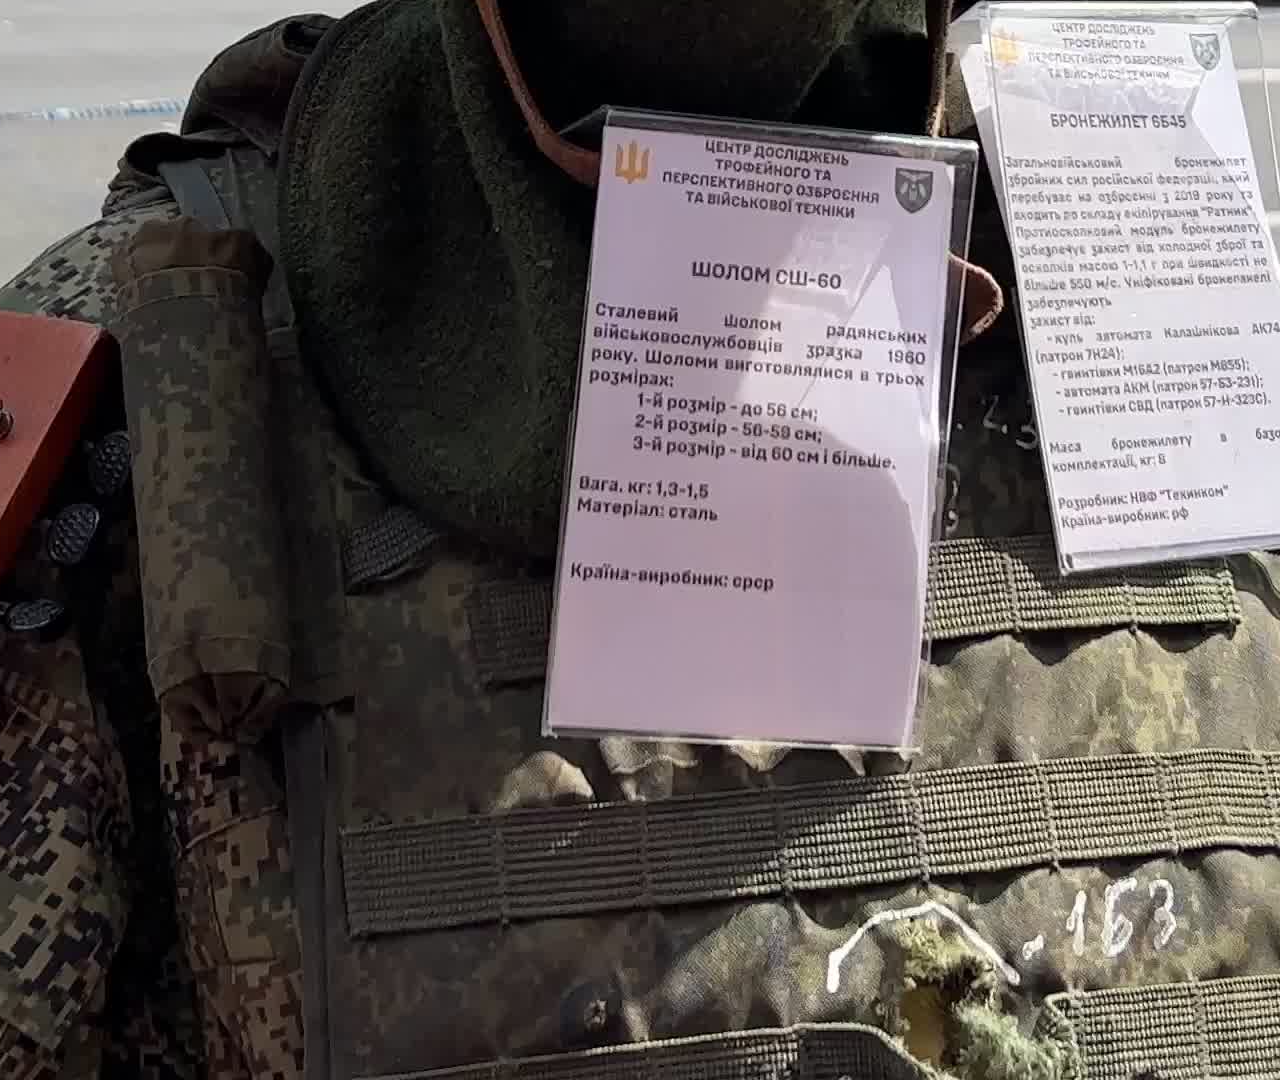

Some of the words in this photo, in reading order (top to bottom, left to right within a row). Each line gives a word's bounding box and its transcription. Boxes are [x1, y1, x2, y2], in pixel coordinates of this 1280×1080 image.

[1052, 23, 1085, 34] ЦЕНТР
[1088, 24, 1155, 35] ДОСЛІДЖЕНЬ
[1063, 36, 1130, 48] ТРОФЕЙНОГО
[1133, 39, 1146, 48] ТА
[1050, 113, 1149, 128] БРОНЕЖИЛЕТ
[1151, 115, 1186, 128] 6Б45
[705, 140, 752, 157] ЦЕНТР
[754, 146, 849, 166] ДОСЛІДЖЕНЬ
[714, 157, 810, 180] ТРОФЕЙНОГО
[814, 168, 831, 181] ТА
[1174, 157, 1247, 170] бронежилет
[662, 172, 793, 195] ПЕРСПЕКТИВНОГО
[796, 186, 879, 204] ОЗБРОЄННЯ
[1008, 172, 1063, 188] збройних
[1066, 175, 1088, 185] сил
[1091, 172, 1153, 187] російської
[686, 191, 704, 205] ТА
[708, 190, 794, 214] ВІЙСЬКОВОЇ
[796, 202, 856, 219] ТЕХНІКИ
[1206, 191, 1234, 202] року
[1130, 226, 1174, 237] модуль
[1181, 223, 1260, 235] бронежилету
[1136, 242, 1154, 253] від
[1215, 239, 1246, 253] зброї
[1250, 239, 1264, 249] та
[691, 261, 770, 284] ШОЛОМ
[775, 269, 841, 290] СШ-60
[1079, 262, 1119, 272] масою
[1070, 278, 1092, 289] 550
[1123, 274, 1194, 288] Уніфіковані
[1027, 296, 1112, 311] забезпечують
[595, 302, 678, 323] Сталевий
[724, 313, 782, 332] шолом
[826, 323, 927, 345] радянських
[1030, 317, 1071, 329] захист
[1055, 332, 1083, 346] куль
[1096, 330, 1152, 341] автомата
[1163, 322, 1240, 339] Калашнікова
[1251, 322, 1280, 335] АК74
[593, 324, 783, 354] військовослужбовців
[806, 343, 862, 362] зразка
[888, 349, 926, 366] 1960
[1035, 348, 1083, 364] (патрон
[591, 348, 639, 366] року.
[645, 350, 718, 370] Шоломи
[724, 358, 853, 382] виготовлялися
[860, 370, 869, 383] в
[875, 372, 925, 390] трьох
[1061, 366, 1121, 380] гвинтівки
[1163, 361, 1208, 376] (патрон
[1064, 385, 1120, 398] автомата
[1123, 381, 1150, 395] АКМ
[1151, 380, 1198, 395] (патрон
[638, 392, 663, 409] 1-й
[667, 396, 726, 415] розмір
[741, 403, 763, 418] до
[767, 404, 787, 417] 56
[791, 408, 818, 422] см;
[1066, 402, 1126, 416] гвинтівки
[1128, 400, 1154, 413] СВД
[1156, 397, 1202, 413] (патрон
[635, 414, 664, 431] 2-й
[667, 418, 727, 437] розмір
[795, 429, 822, 444] см;
[633, 435, 662, 453] 3-й
[666, 440, 726, 459] розмір
[741, 444, 767, 462] від
[772, 447, 793, 462] 60
[797, 452, 819, 464] см
[823, 449, 828, 464] і
[832, 450, 896, 470] більше.
[1050, 442, 1082, 454] Маса
[1111, 435, 1192, 451] бронежилету
[1220, 433, 1227, 442] в
[628, 482, 652, 495] кг:
[655, 481, 709, 498] 1,3-1,5
[577, 498, 665, 518] Матеріал:
[668, 508, 718, 521] сталь
[1058, 493, 1128, 511] Розробник:
[1130, 490, 1157, 504] НВФ
[1061, 508, 1169, 529] Країна-виробник:
[1172, 506, 1189, 521] рф
[570, 562, 728, 589] Країна-виробник:
[732, 576, 774, 592] срср
